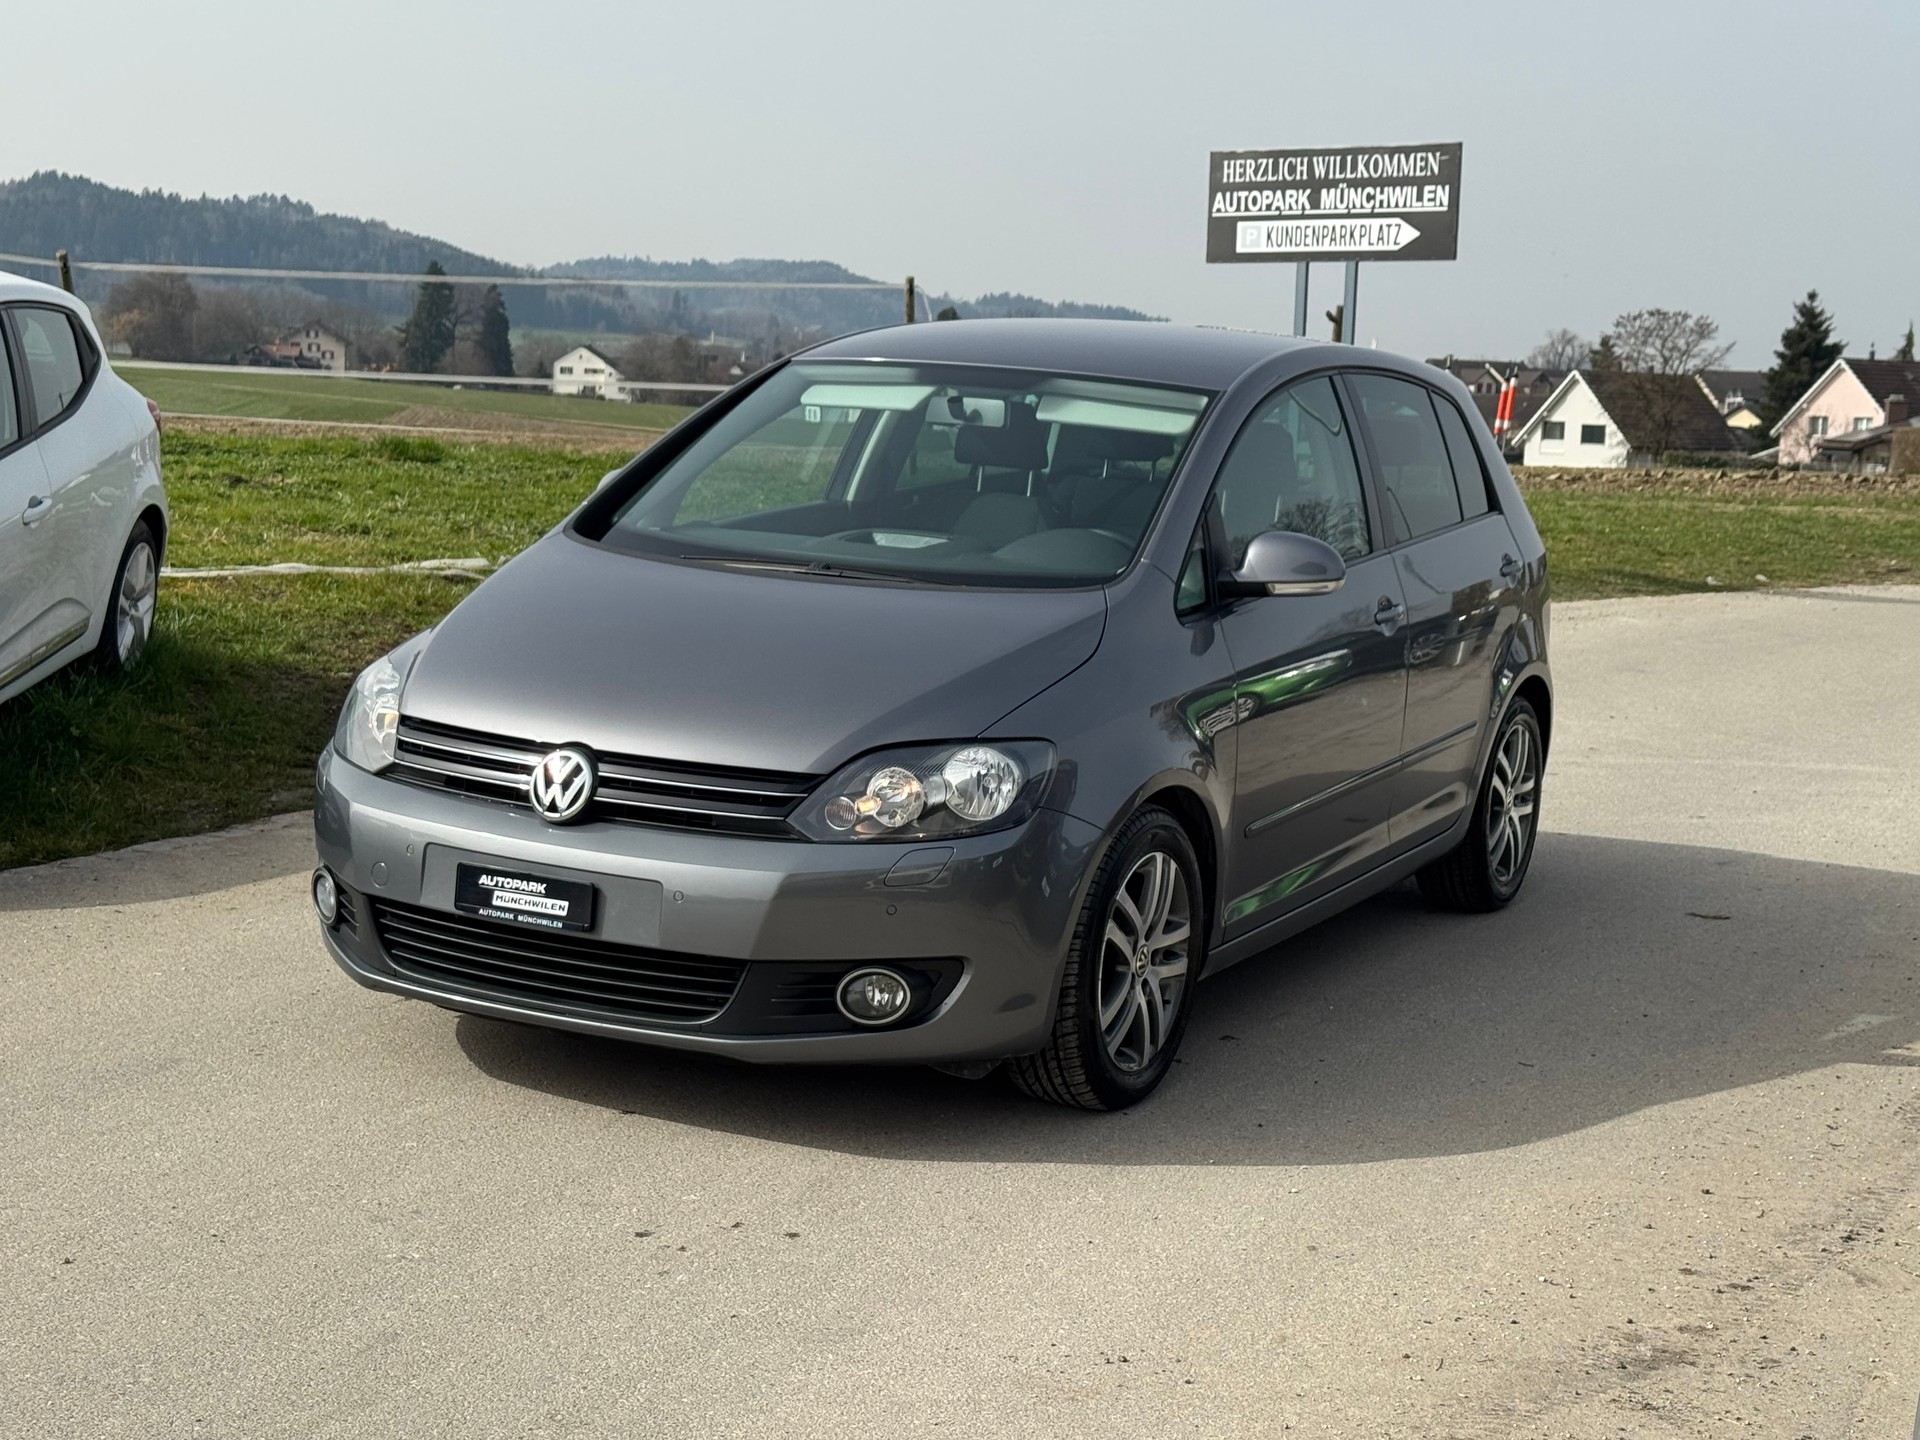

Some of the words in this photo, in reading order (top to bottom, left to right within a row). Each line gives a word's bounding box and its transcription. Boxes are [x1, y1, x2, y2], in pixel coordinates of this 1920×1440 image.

[1222, 156, 1309, 184] HERZLICH
[1312, 151, 1442, 181] WILLKOMMEN
[1212, 188, 1311, 213] AUTOPARK
[1320, 183, 1450, 210] MÜNCHWILEN
[1265, 223, 1402, 249] KUNDENPARKPLATZ
[478, 874, 547, 894] AUTOPARK
[495, 894, 566, 912] MÜNCHWILEN
[478, 908, 514, 920] AUTOPARK
[517, 914, 563, 929] MÜNCHWILEN
